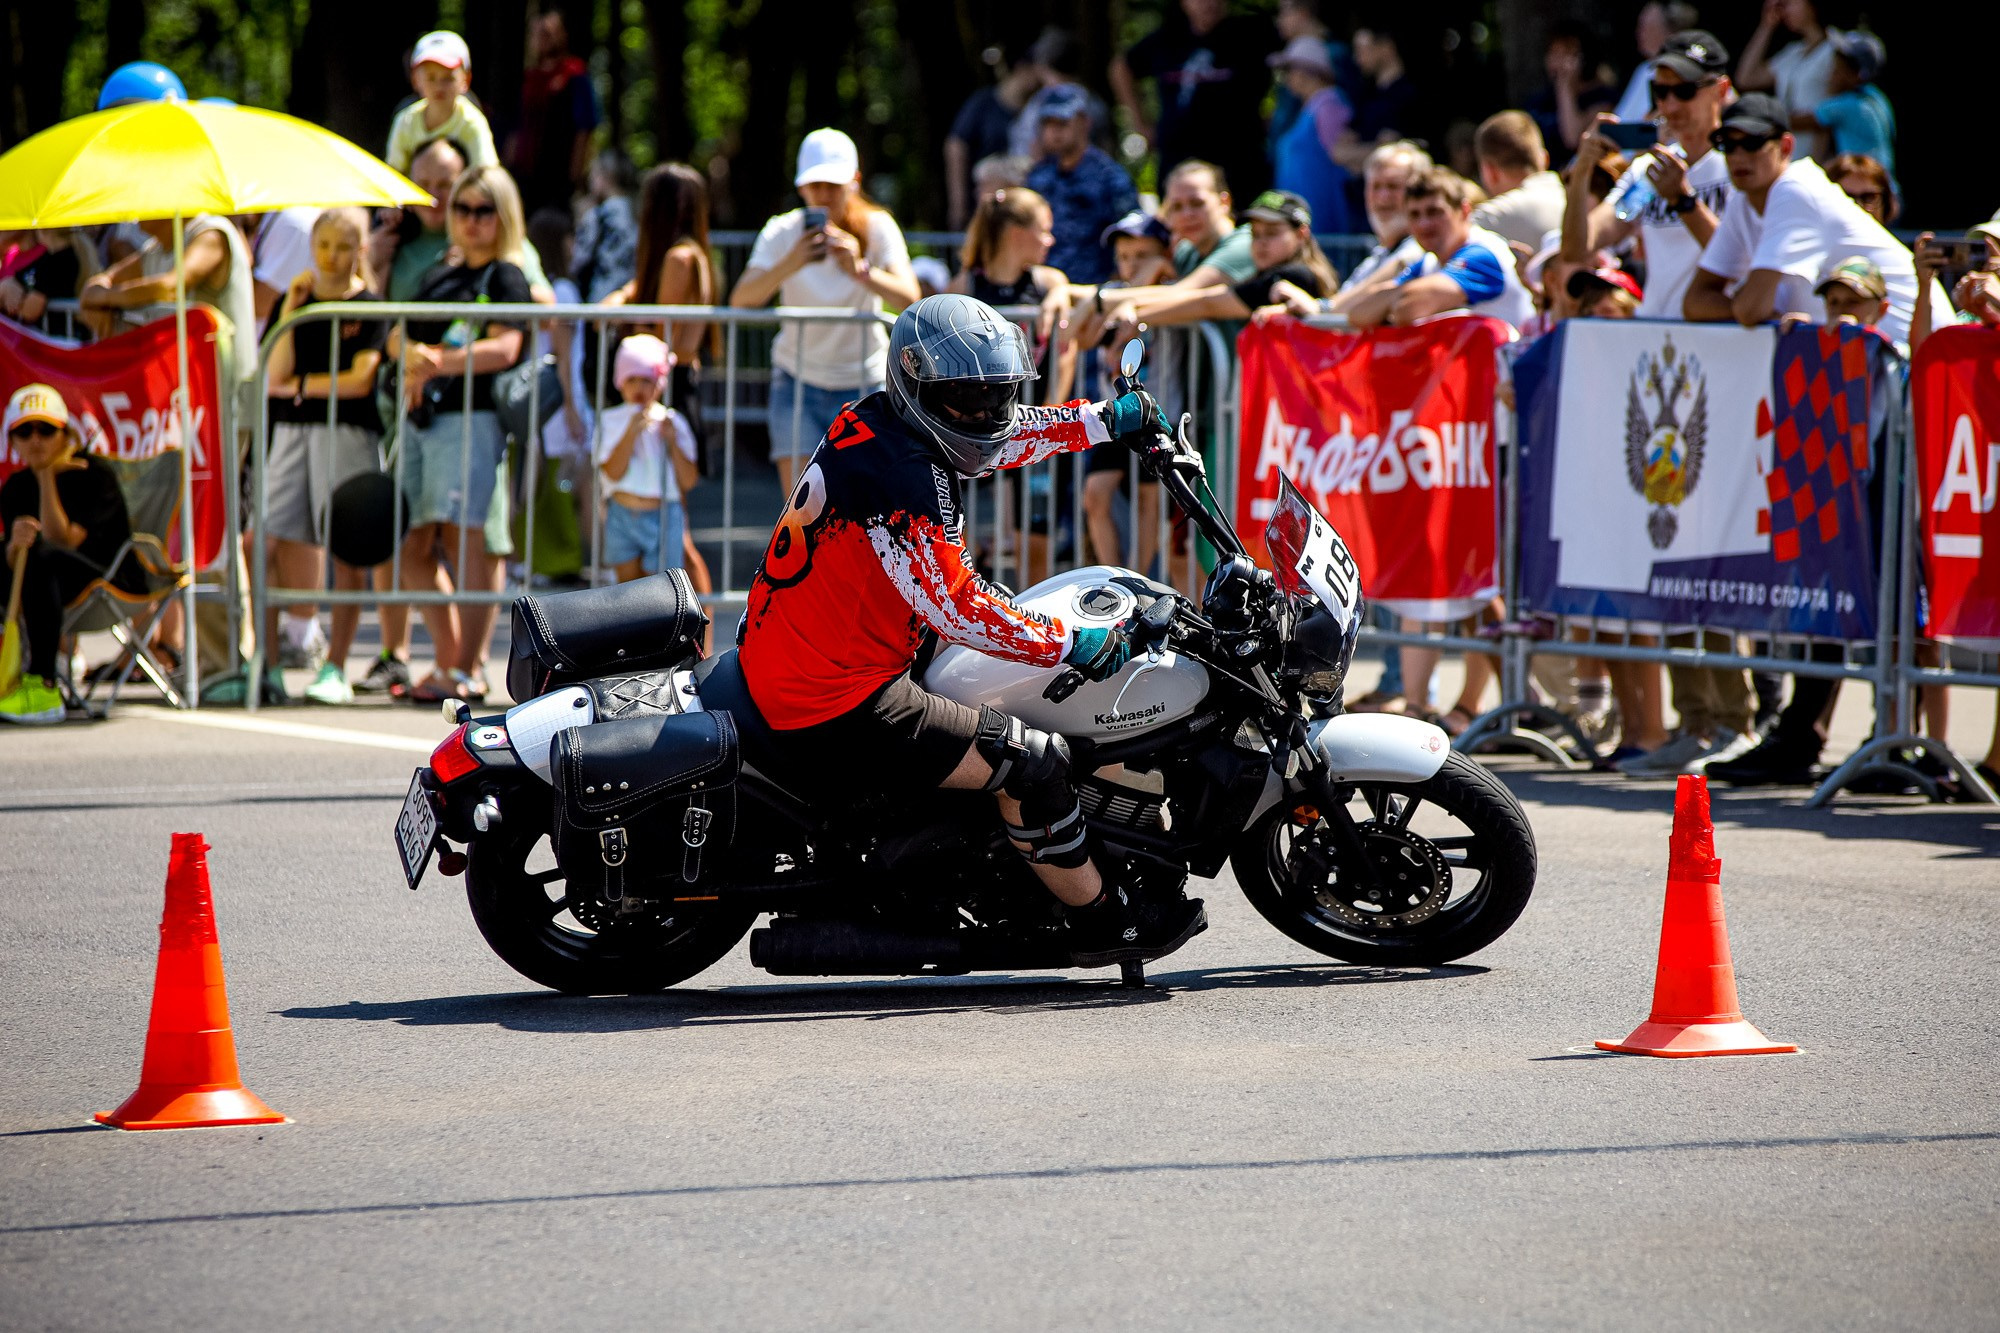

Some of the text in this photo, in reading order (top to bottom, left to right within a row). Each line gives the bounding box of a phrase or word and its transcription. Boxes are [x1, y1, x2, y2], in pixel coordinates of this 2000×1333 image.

[828, 409, 876, 450] 67
[765, 462, 827, 580] 8
[1325, 538, 1354, 608] 08
[1094, 702, 1165, 725] Kawasaki
